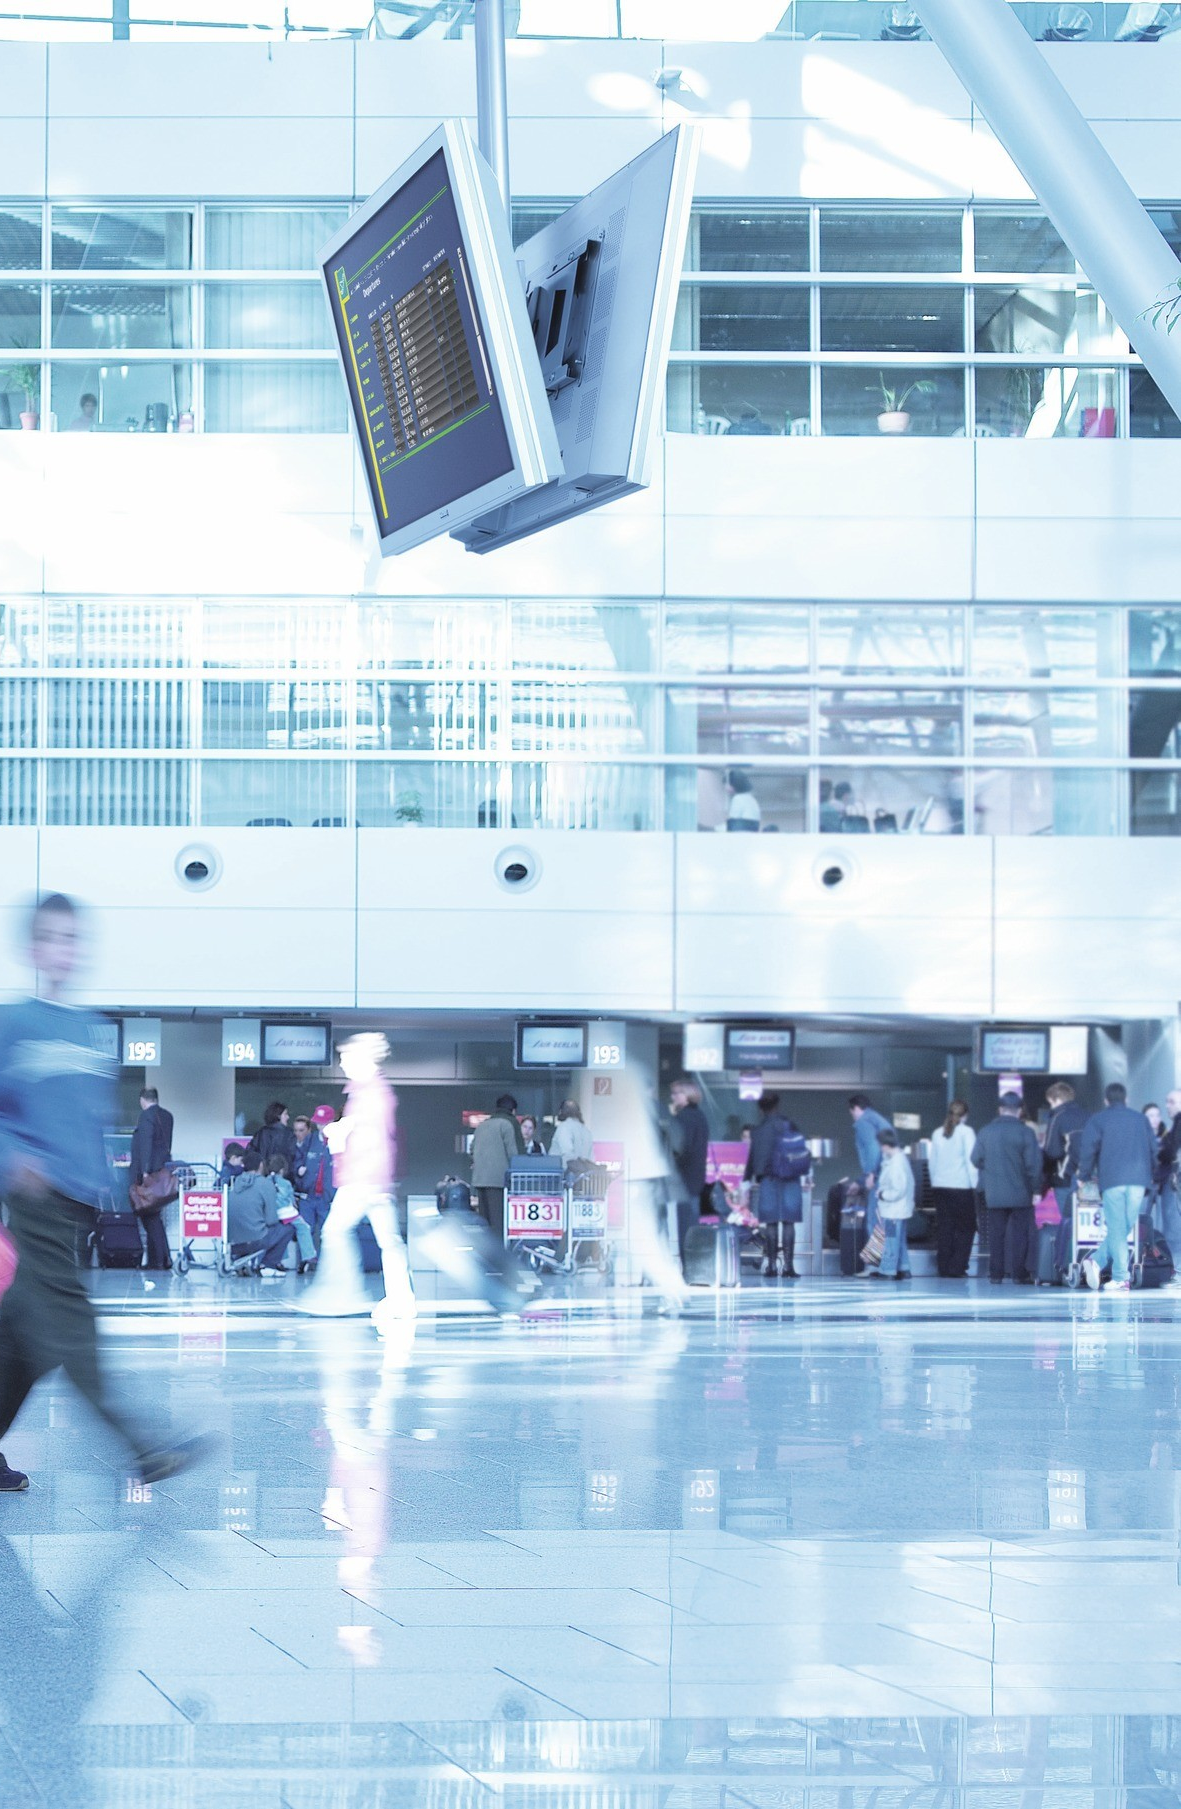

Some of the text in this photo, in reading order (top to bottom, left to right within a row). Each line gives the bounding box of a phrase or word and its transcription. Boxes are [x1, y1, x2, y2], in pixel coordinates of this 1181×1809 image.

[128, 1042, 156, 1060] 195
[227, 1043, 255, 1061] 194
[593, 1045, 620, 1064] 193
